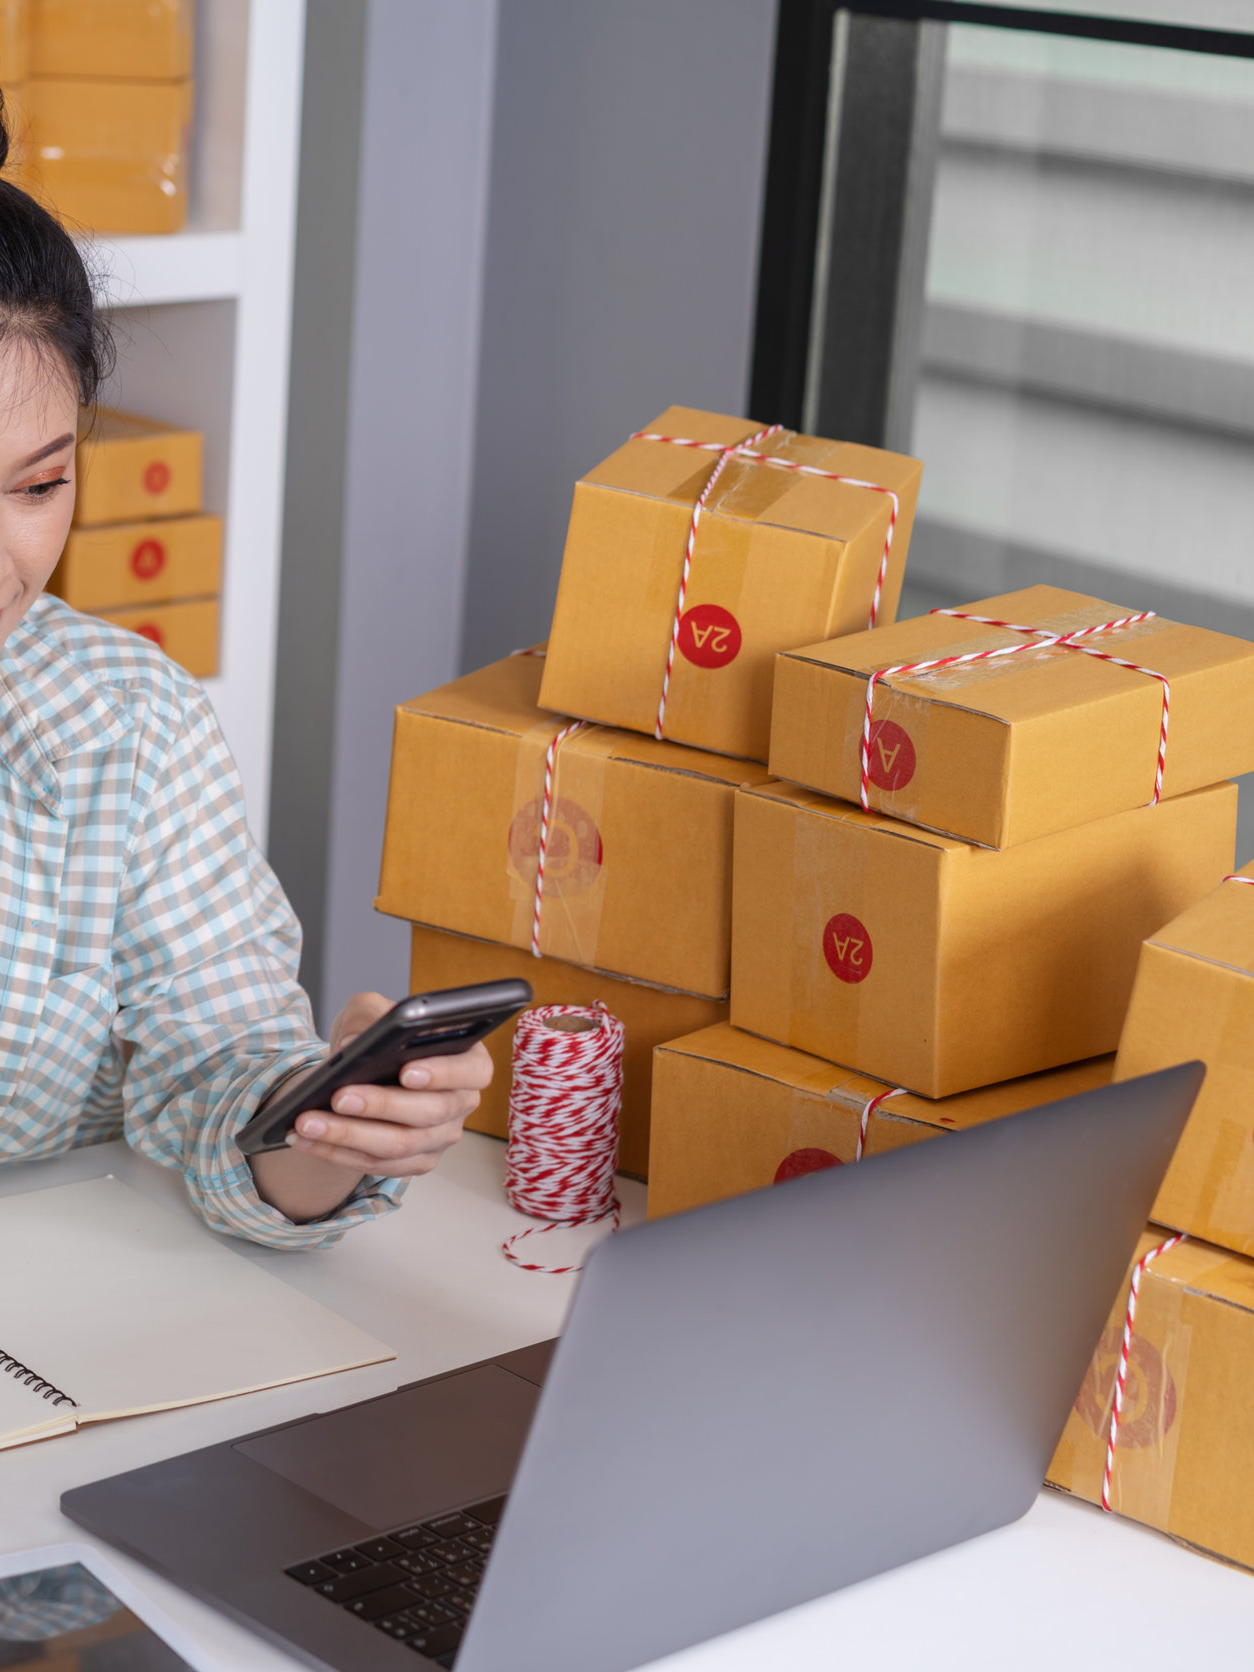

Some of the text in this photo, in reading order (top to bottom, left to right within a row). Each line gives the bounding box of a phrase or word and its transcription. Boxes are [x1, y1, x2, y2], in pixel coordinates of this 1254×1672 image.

[690, 620, 731, 653] 2A
[876, 736, 902, 774] A
[832, 931, 864, 966] 2A
